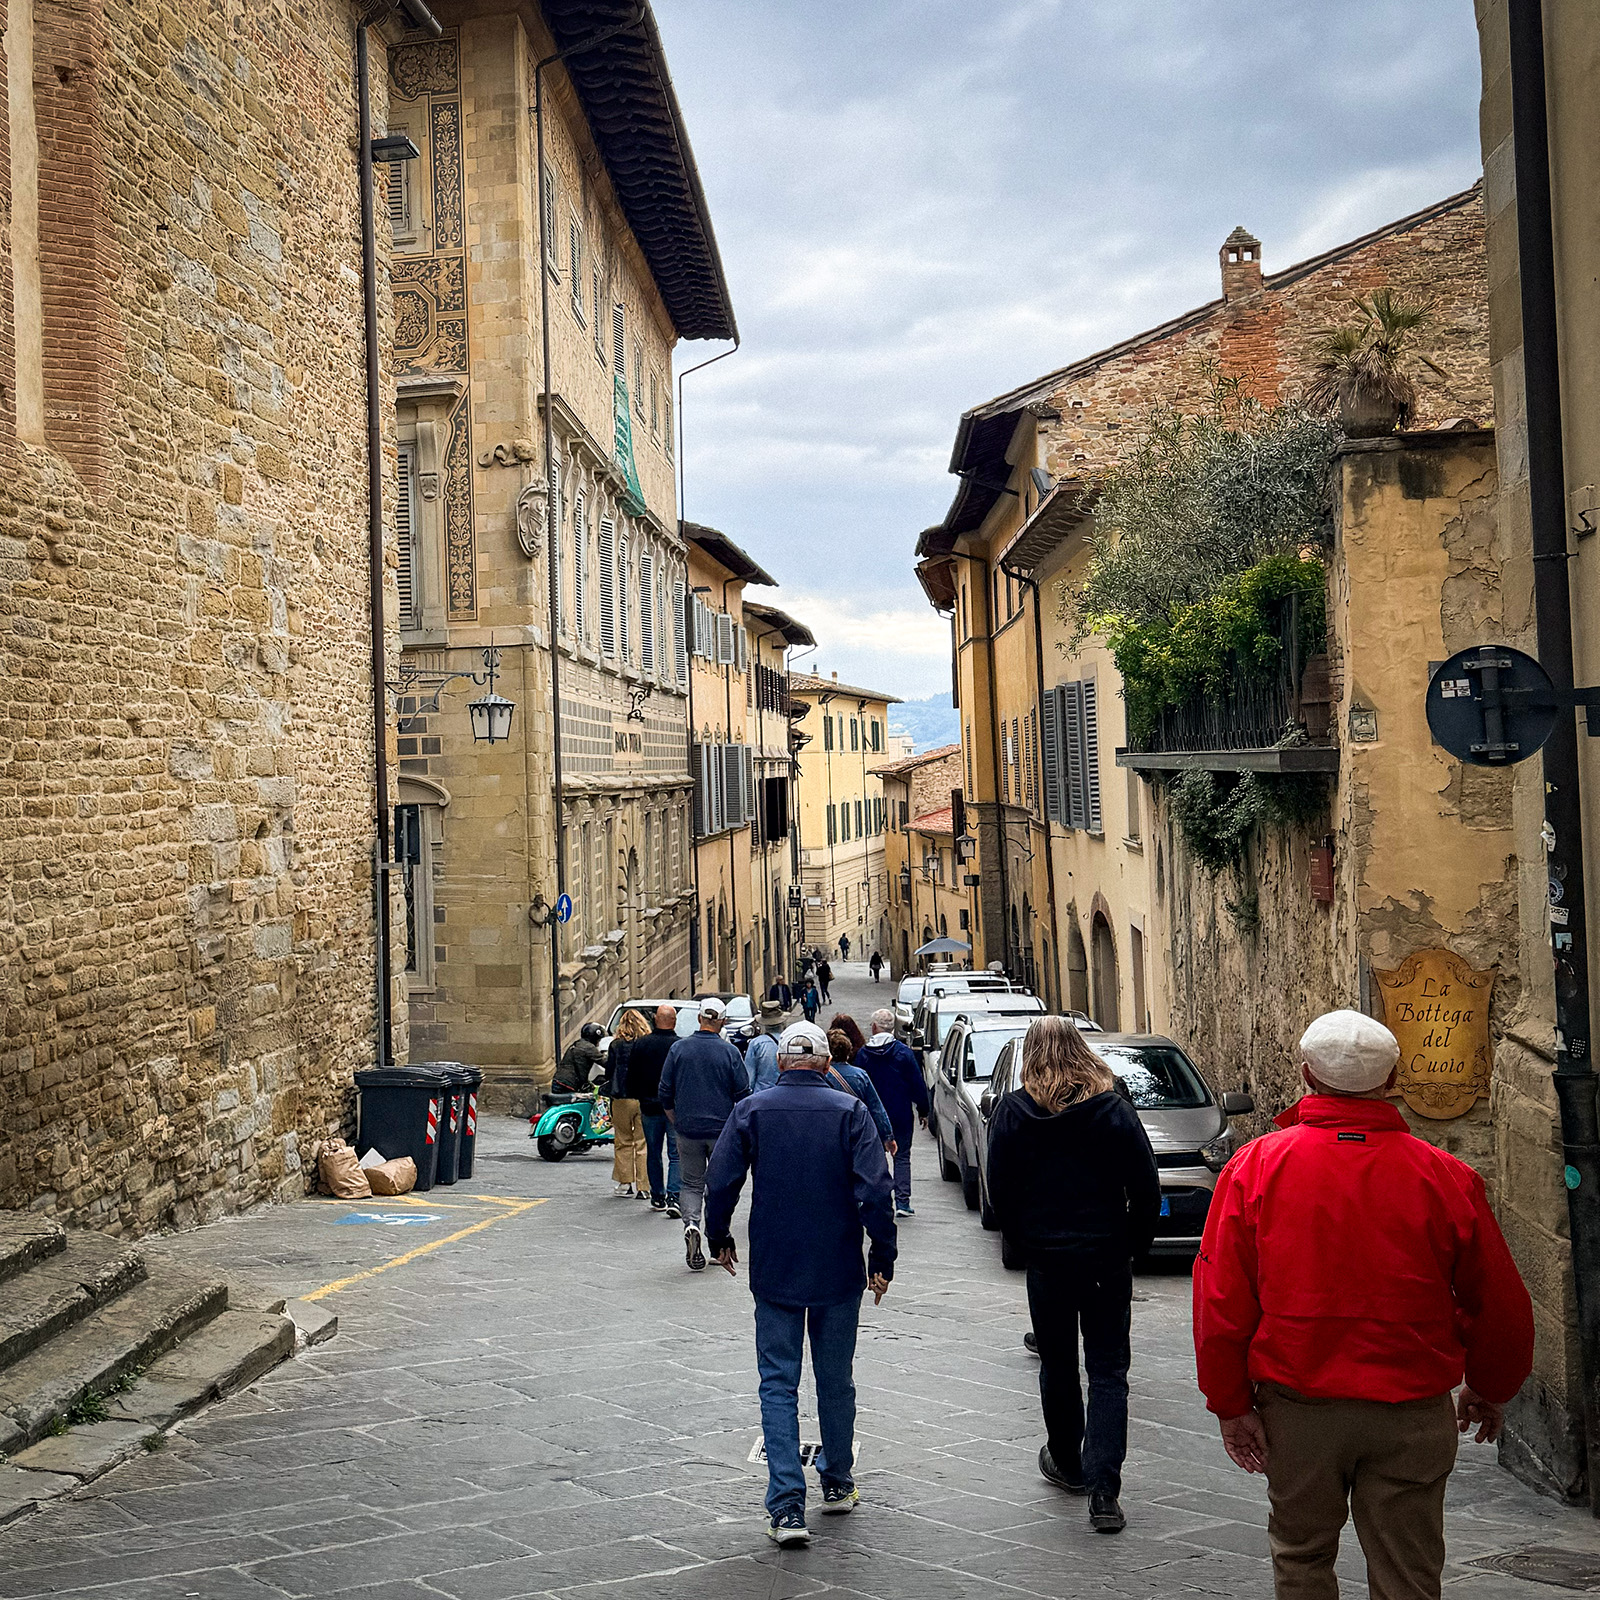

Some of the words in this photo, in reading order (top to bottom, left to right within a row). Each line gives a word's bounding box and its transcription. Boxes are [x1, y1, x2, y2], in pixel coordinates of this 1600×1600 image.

[1420, 977, 1451, 998] La
[1396, 1002, 1474, 1030] Bottega
[1422, 1027, 1452, 1048] del
[1410, 1053, 1465, 1074] Cuoio
